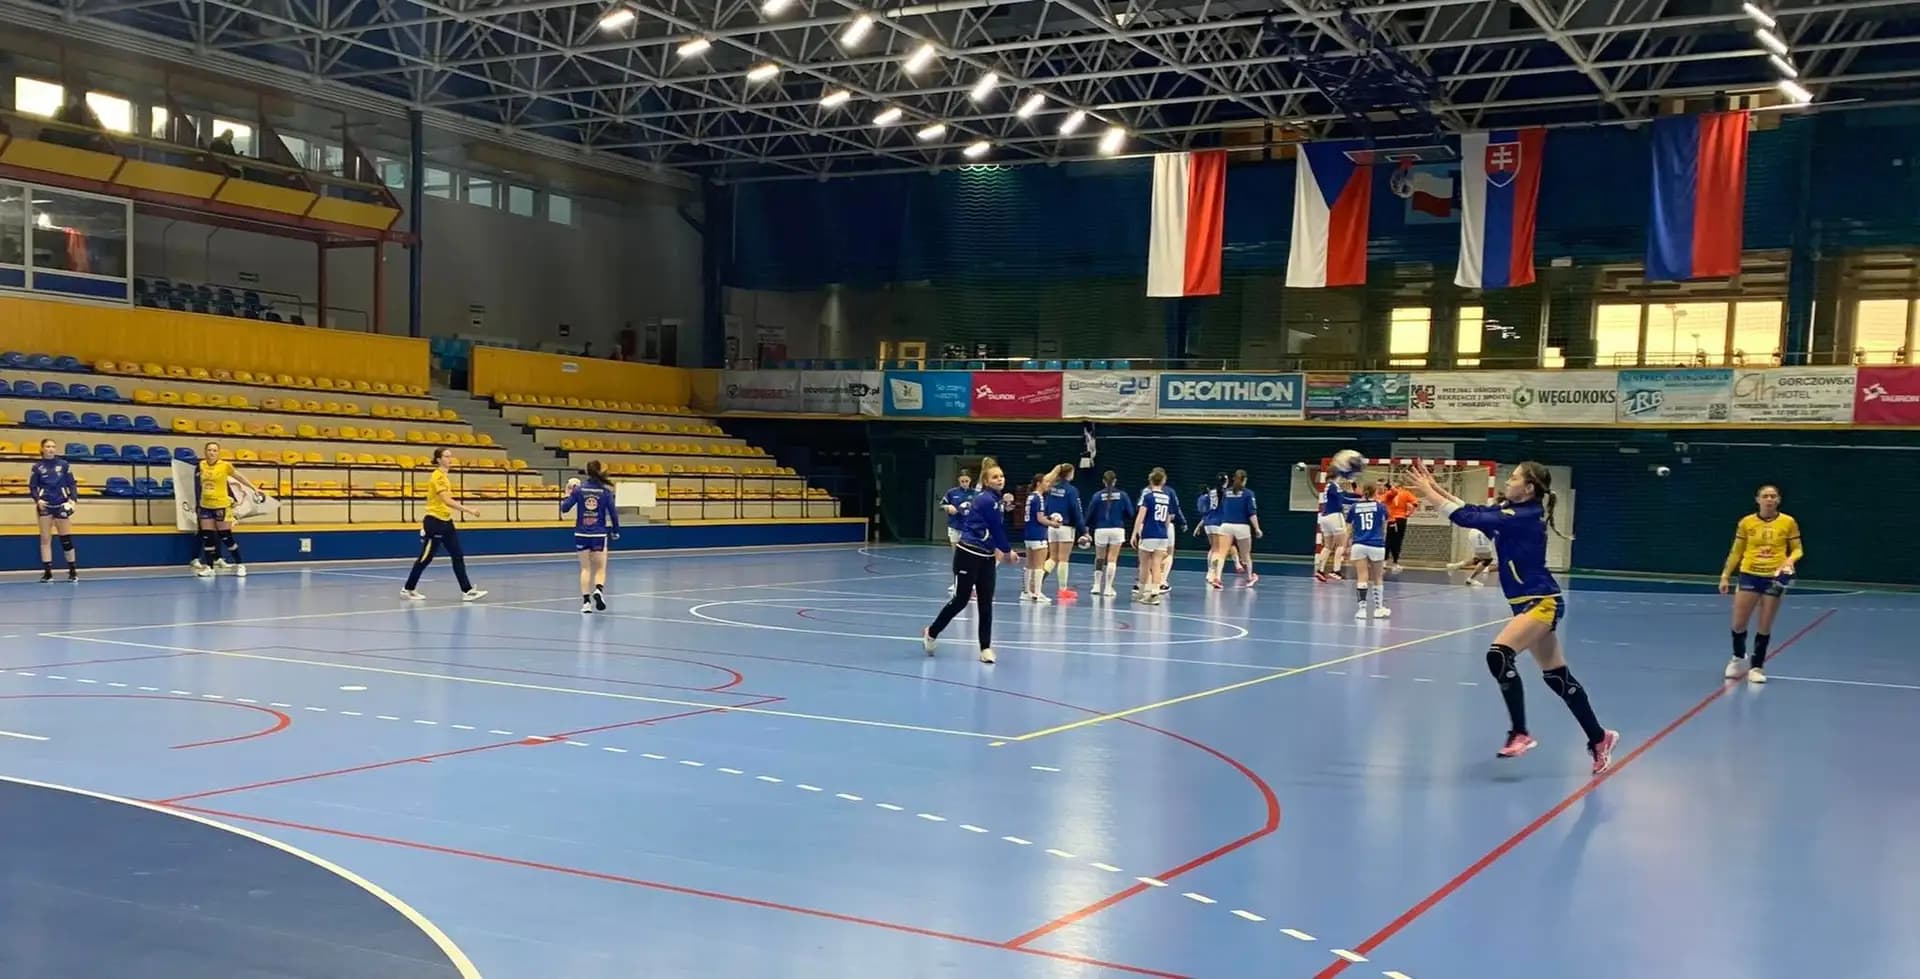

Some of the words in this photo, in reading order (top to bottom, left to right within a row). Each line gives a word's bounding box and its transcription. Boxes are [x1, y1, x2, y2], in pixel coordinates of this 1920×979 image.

[1778, 376, 1854, 386] GORCZOWSKI
[1168, 381, 1294, 401] DECATHLON
[1538, 390, 1616, 406] WĘGLOKOKS
[1777, 389, 1812, 399] HOTEL
[1154, 504, 1168, 521] 20
[1359, 512, 1373, 530] 15
